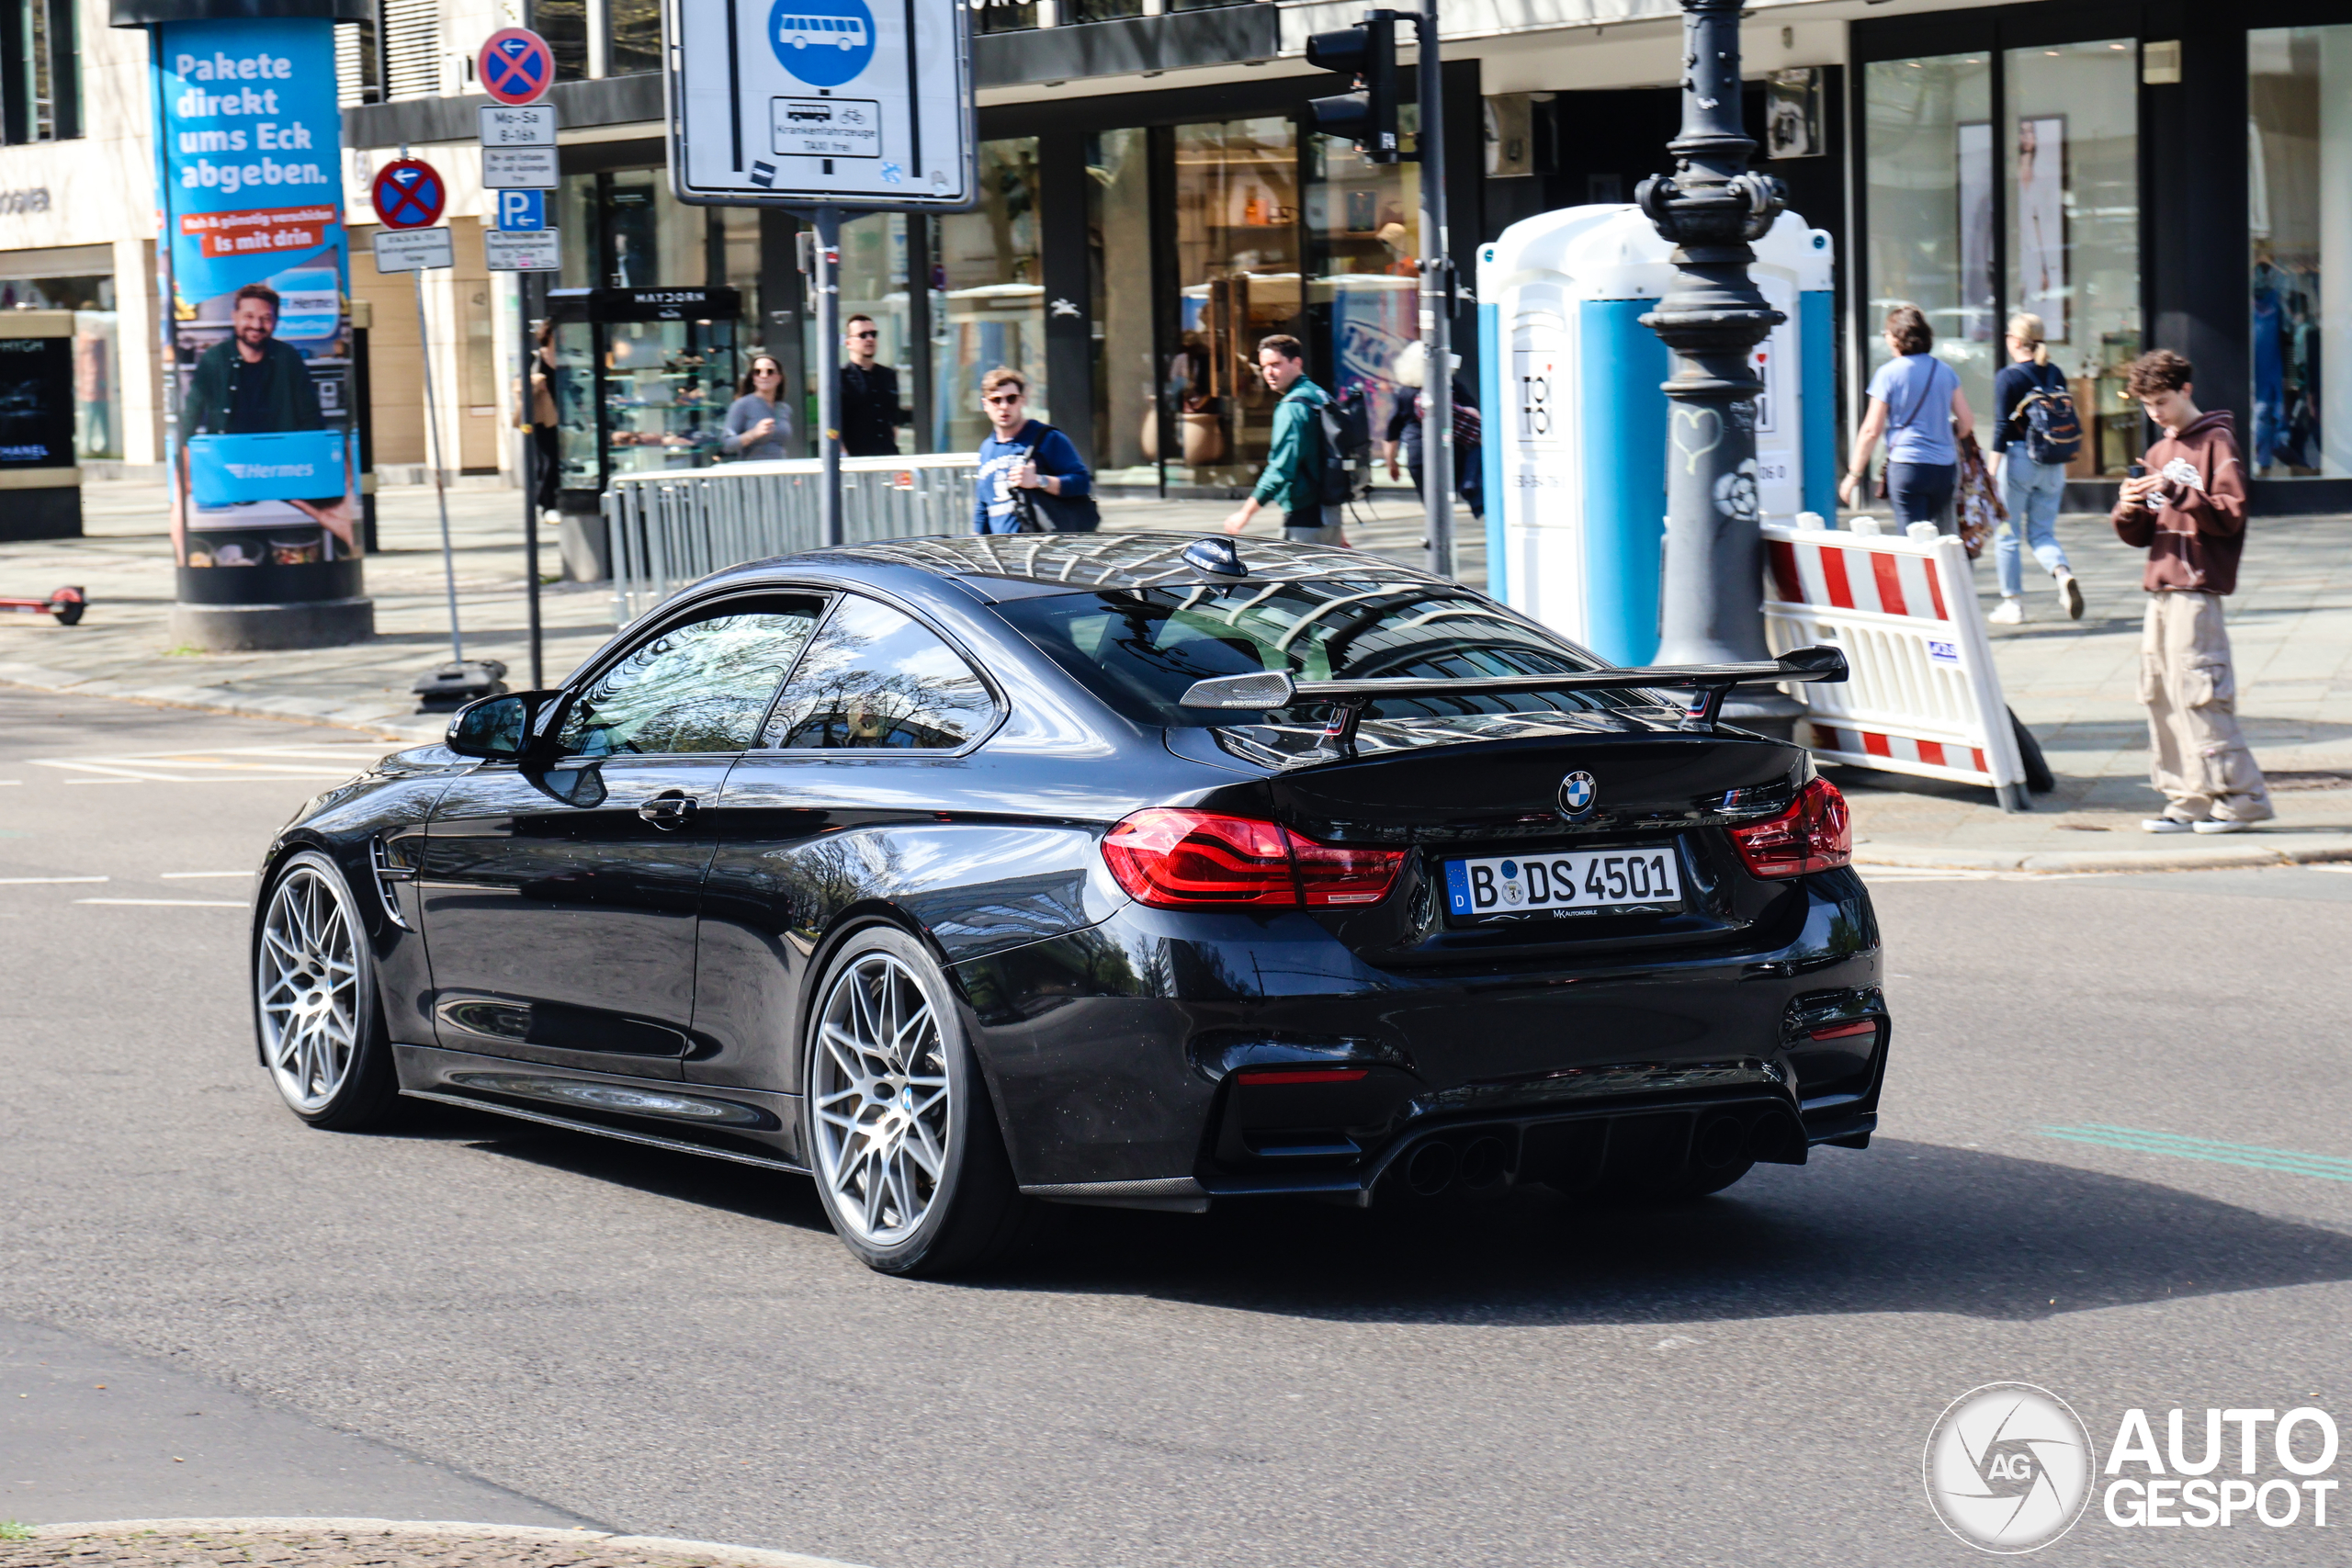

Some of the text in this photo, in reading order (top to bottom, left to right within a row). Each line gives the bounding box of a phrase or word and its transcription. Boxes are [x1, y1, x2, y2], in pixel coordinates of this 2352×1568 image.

[175, 51, 292, 82] Pakete
[176, 86, 279, 118] direkt
[494, 111, 540, 124] Mo-Sa
[178, 121, 313, 153] ums Eck
[776, 125, 876, 140] Krankenfahrzeuge
[803, 141, 852, 152] TAXI frei
[181, 156, 328, 194] abgeben.
[220, 212, 271, 229] günstig
[214, 227, 313, 253] Is mit drin
[246, 463, 314, 478] Hermes
[1564, 773, 1595, 788] BMW
[1471, 855, 1675, 908] B DS 4501
[1455, 895, 1464, 908] D
